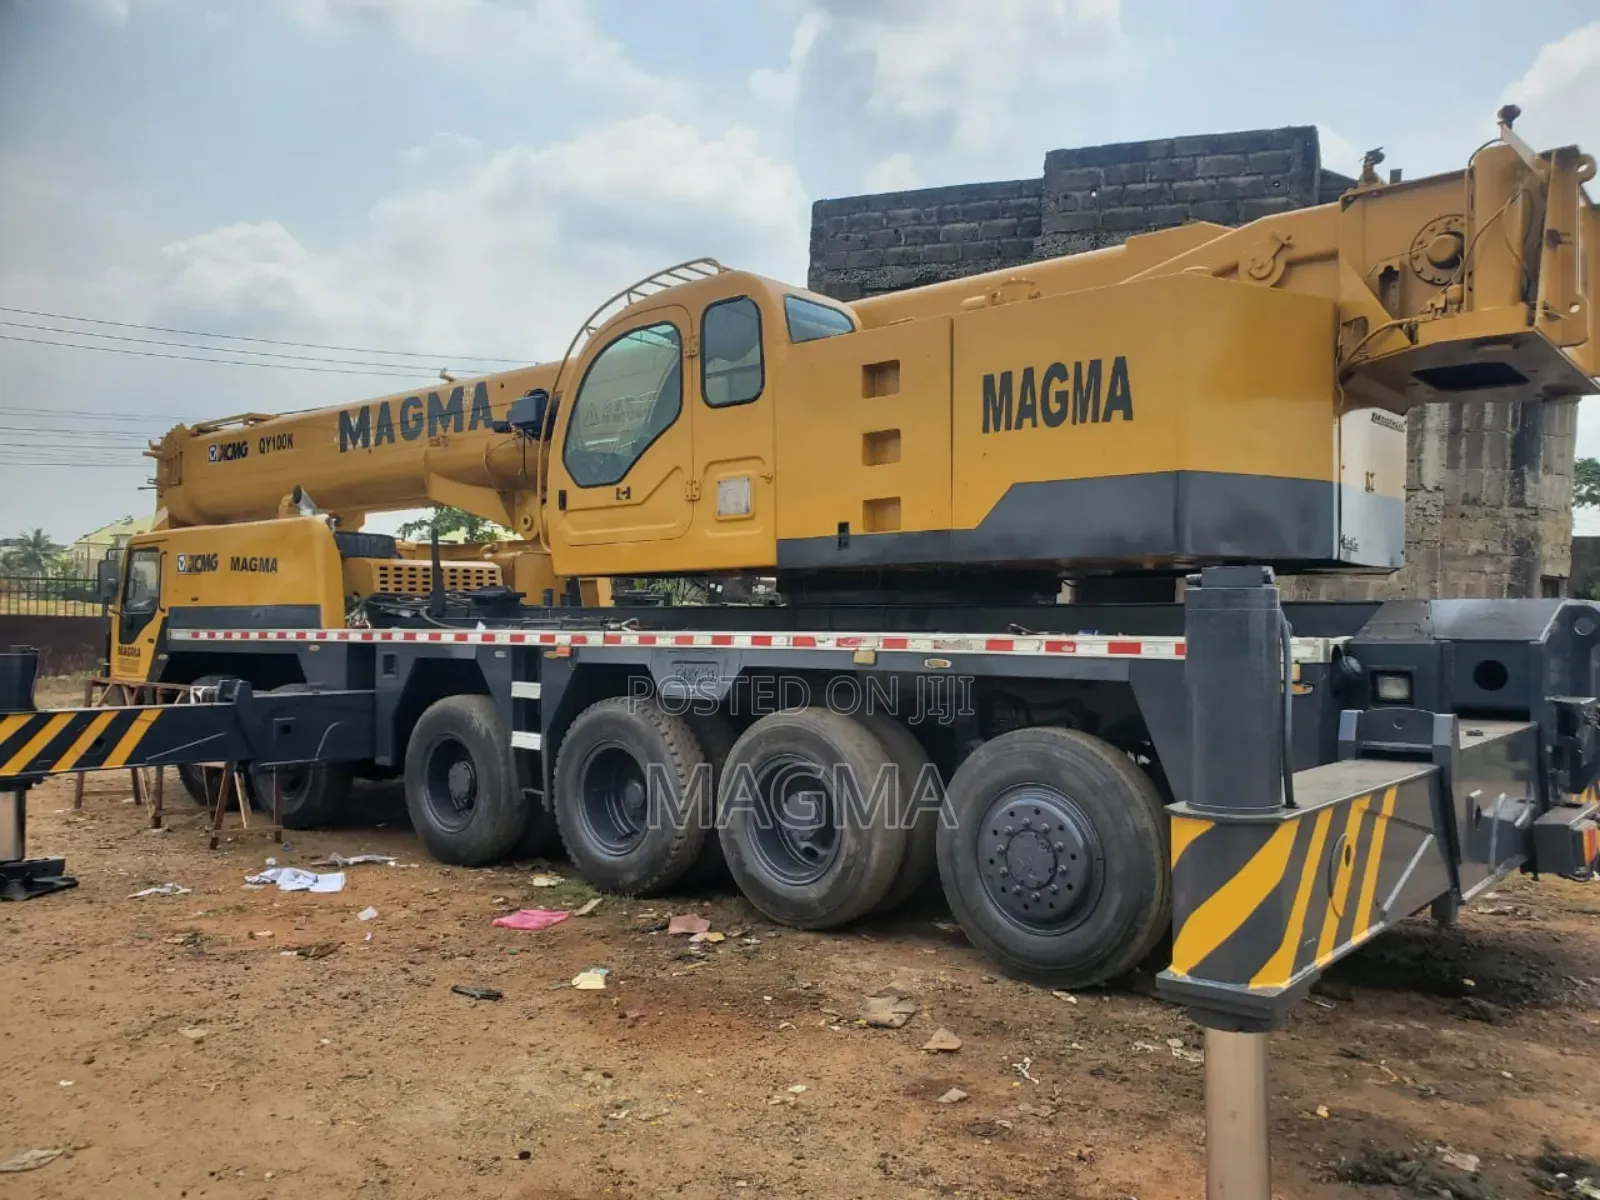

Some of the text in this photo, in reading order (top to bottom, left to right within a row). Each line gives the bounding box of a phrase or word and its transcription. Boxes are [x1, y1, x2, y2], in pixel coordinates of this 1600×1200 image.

[982, 356, 1133, 434] MAGMA
[339, 381, 493, 453] MAGMA
[259, 433, 294, 454] QY100K
[230, 556, 278, 573] MAGMA
[118, 645, 141, 657] MAGMA
